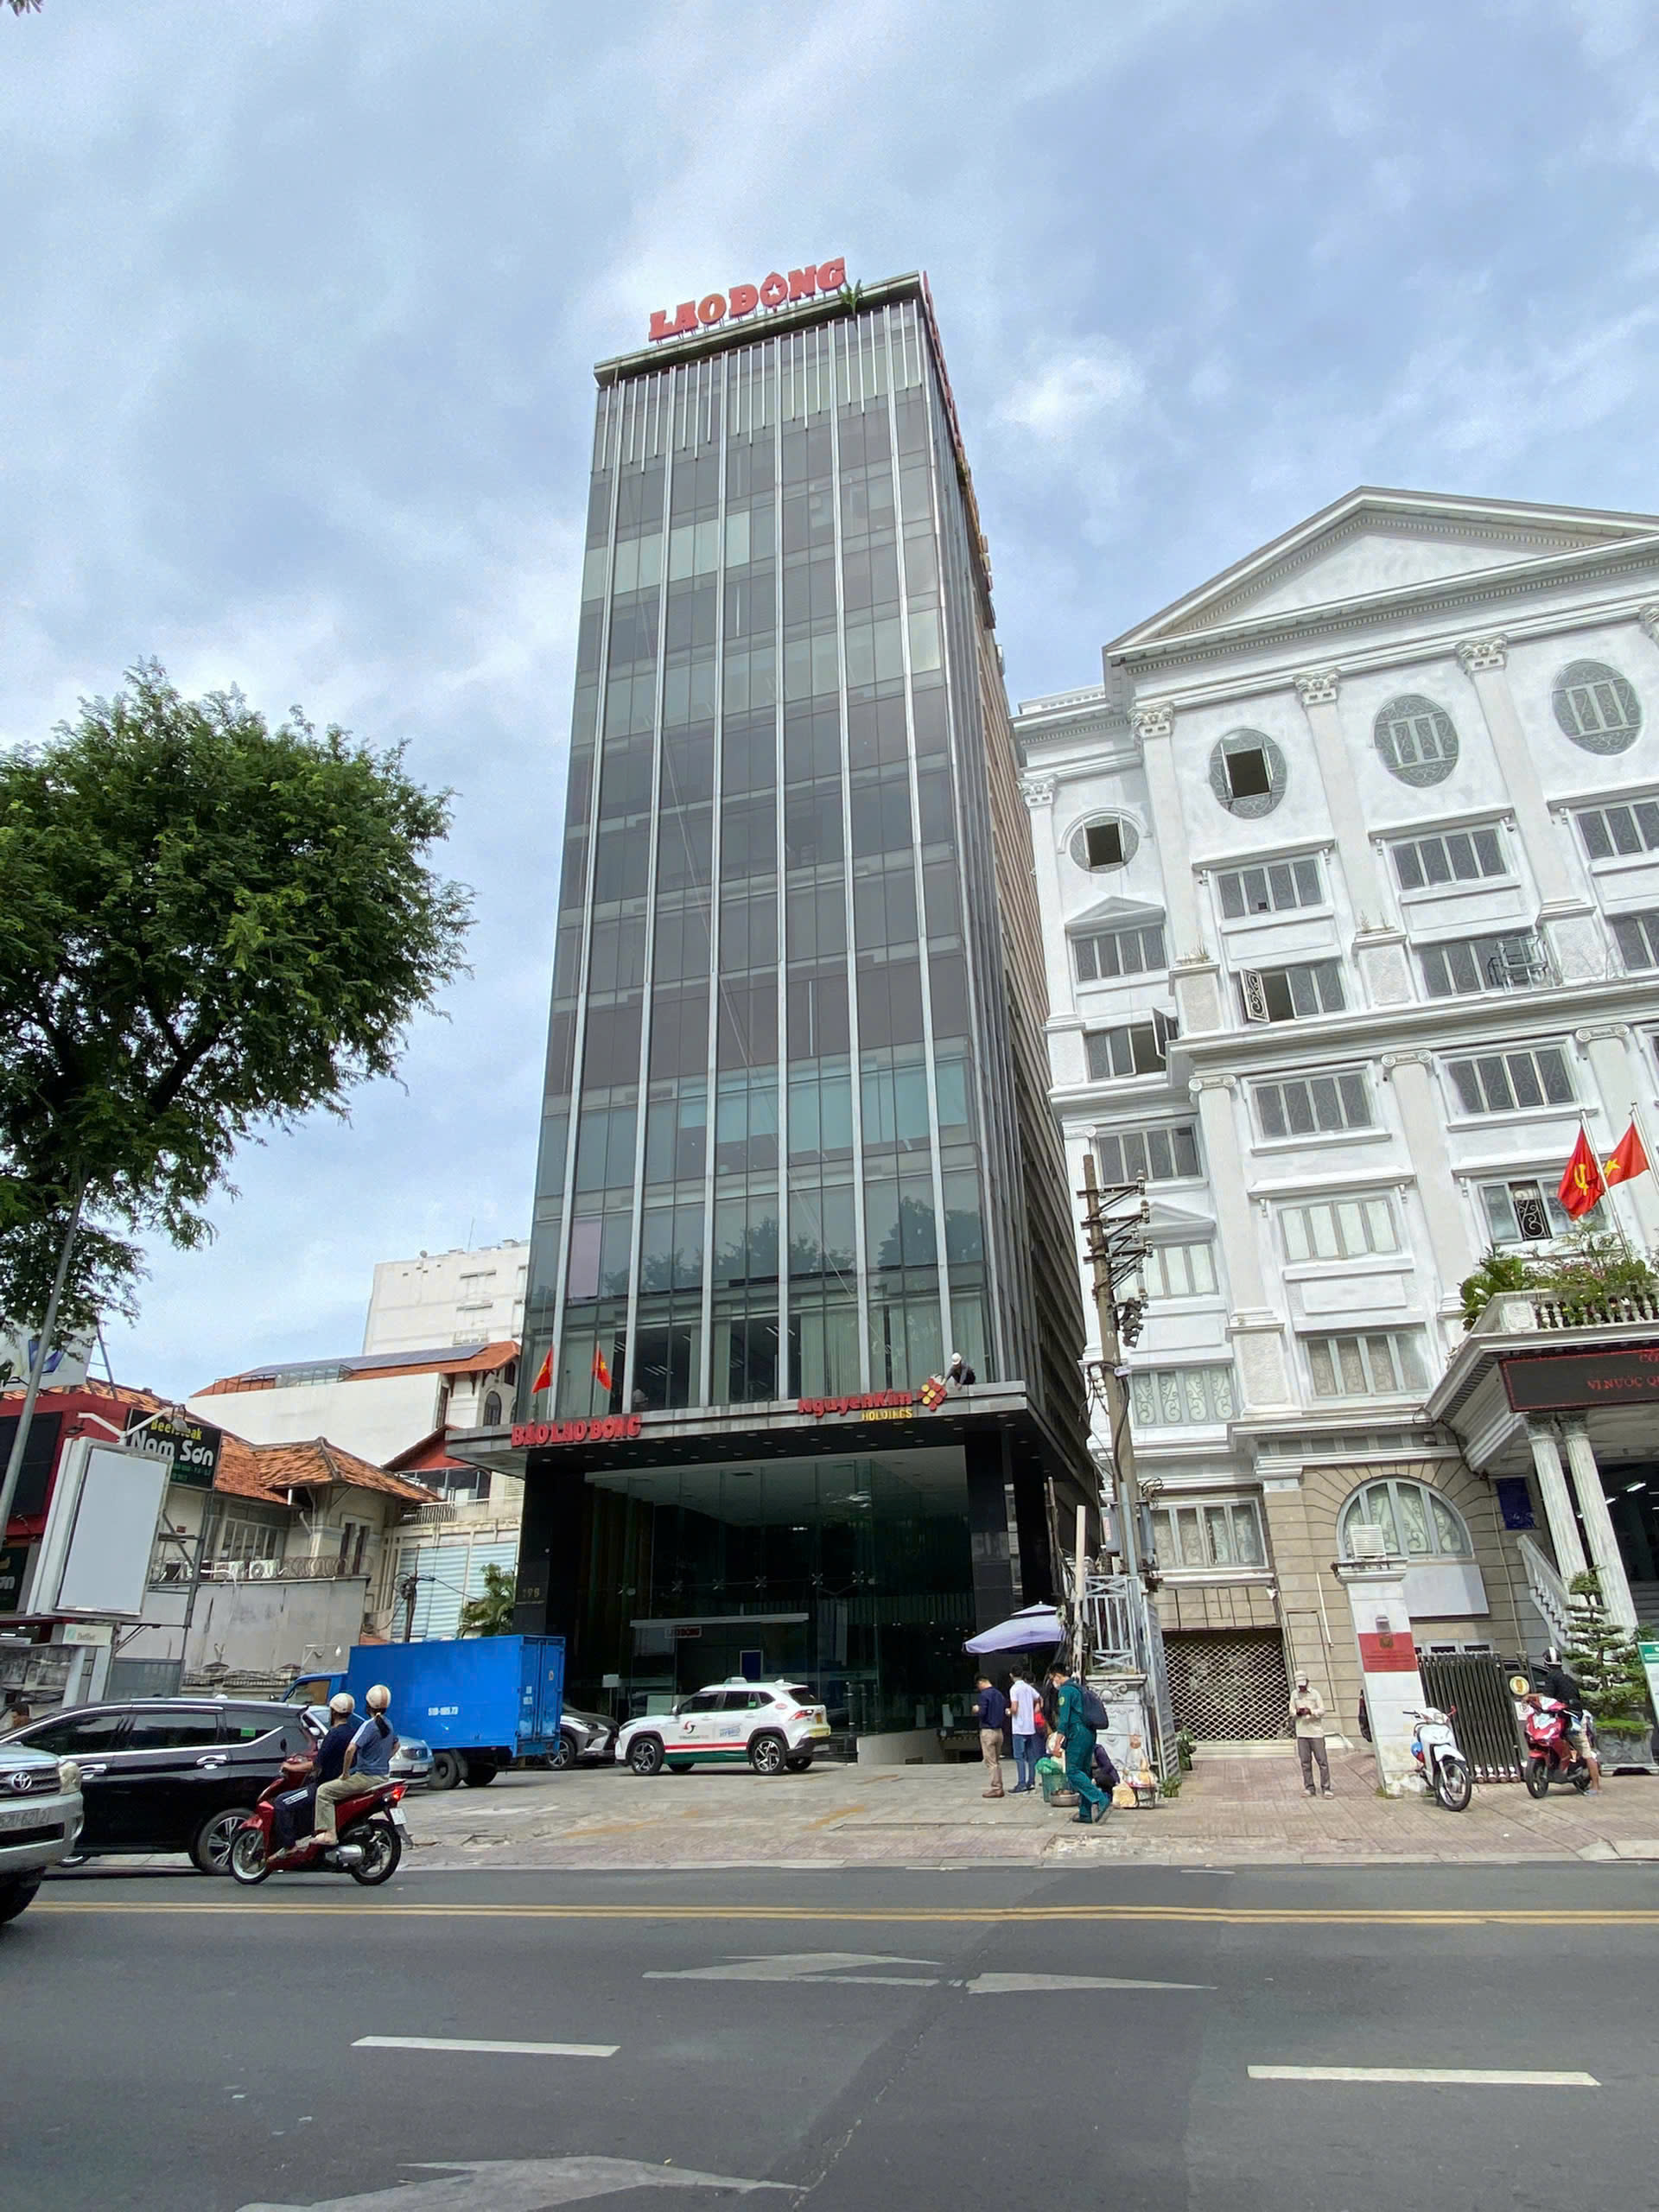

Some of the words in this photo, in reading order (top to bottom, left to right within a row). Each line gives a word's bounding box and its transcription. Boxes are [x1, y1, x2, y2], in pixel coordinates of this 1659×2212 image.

[648, 293, 727, 342] LAO
[130, 1430, 175, 1457] Nam
[180, 1439, 214, 1466] Sơn
